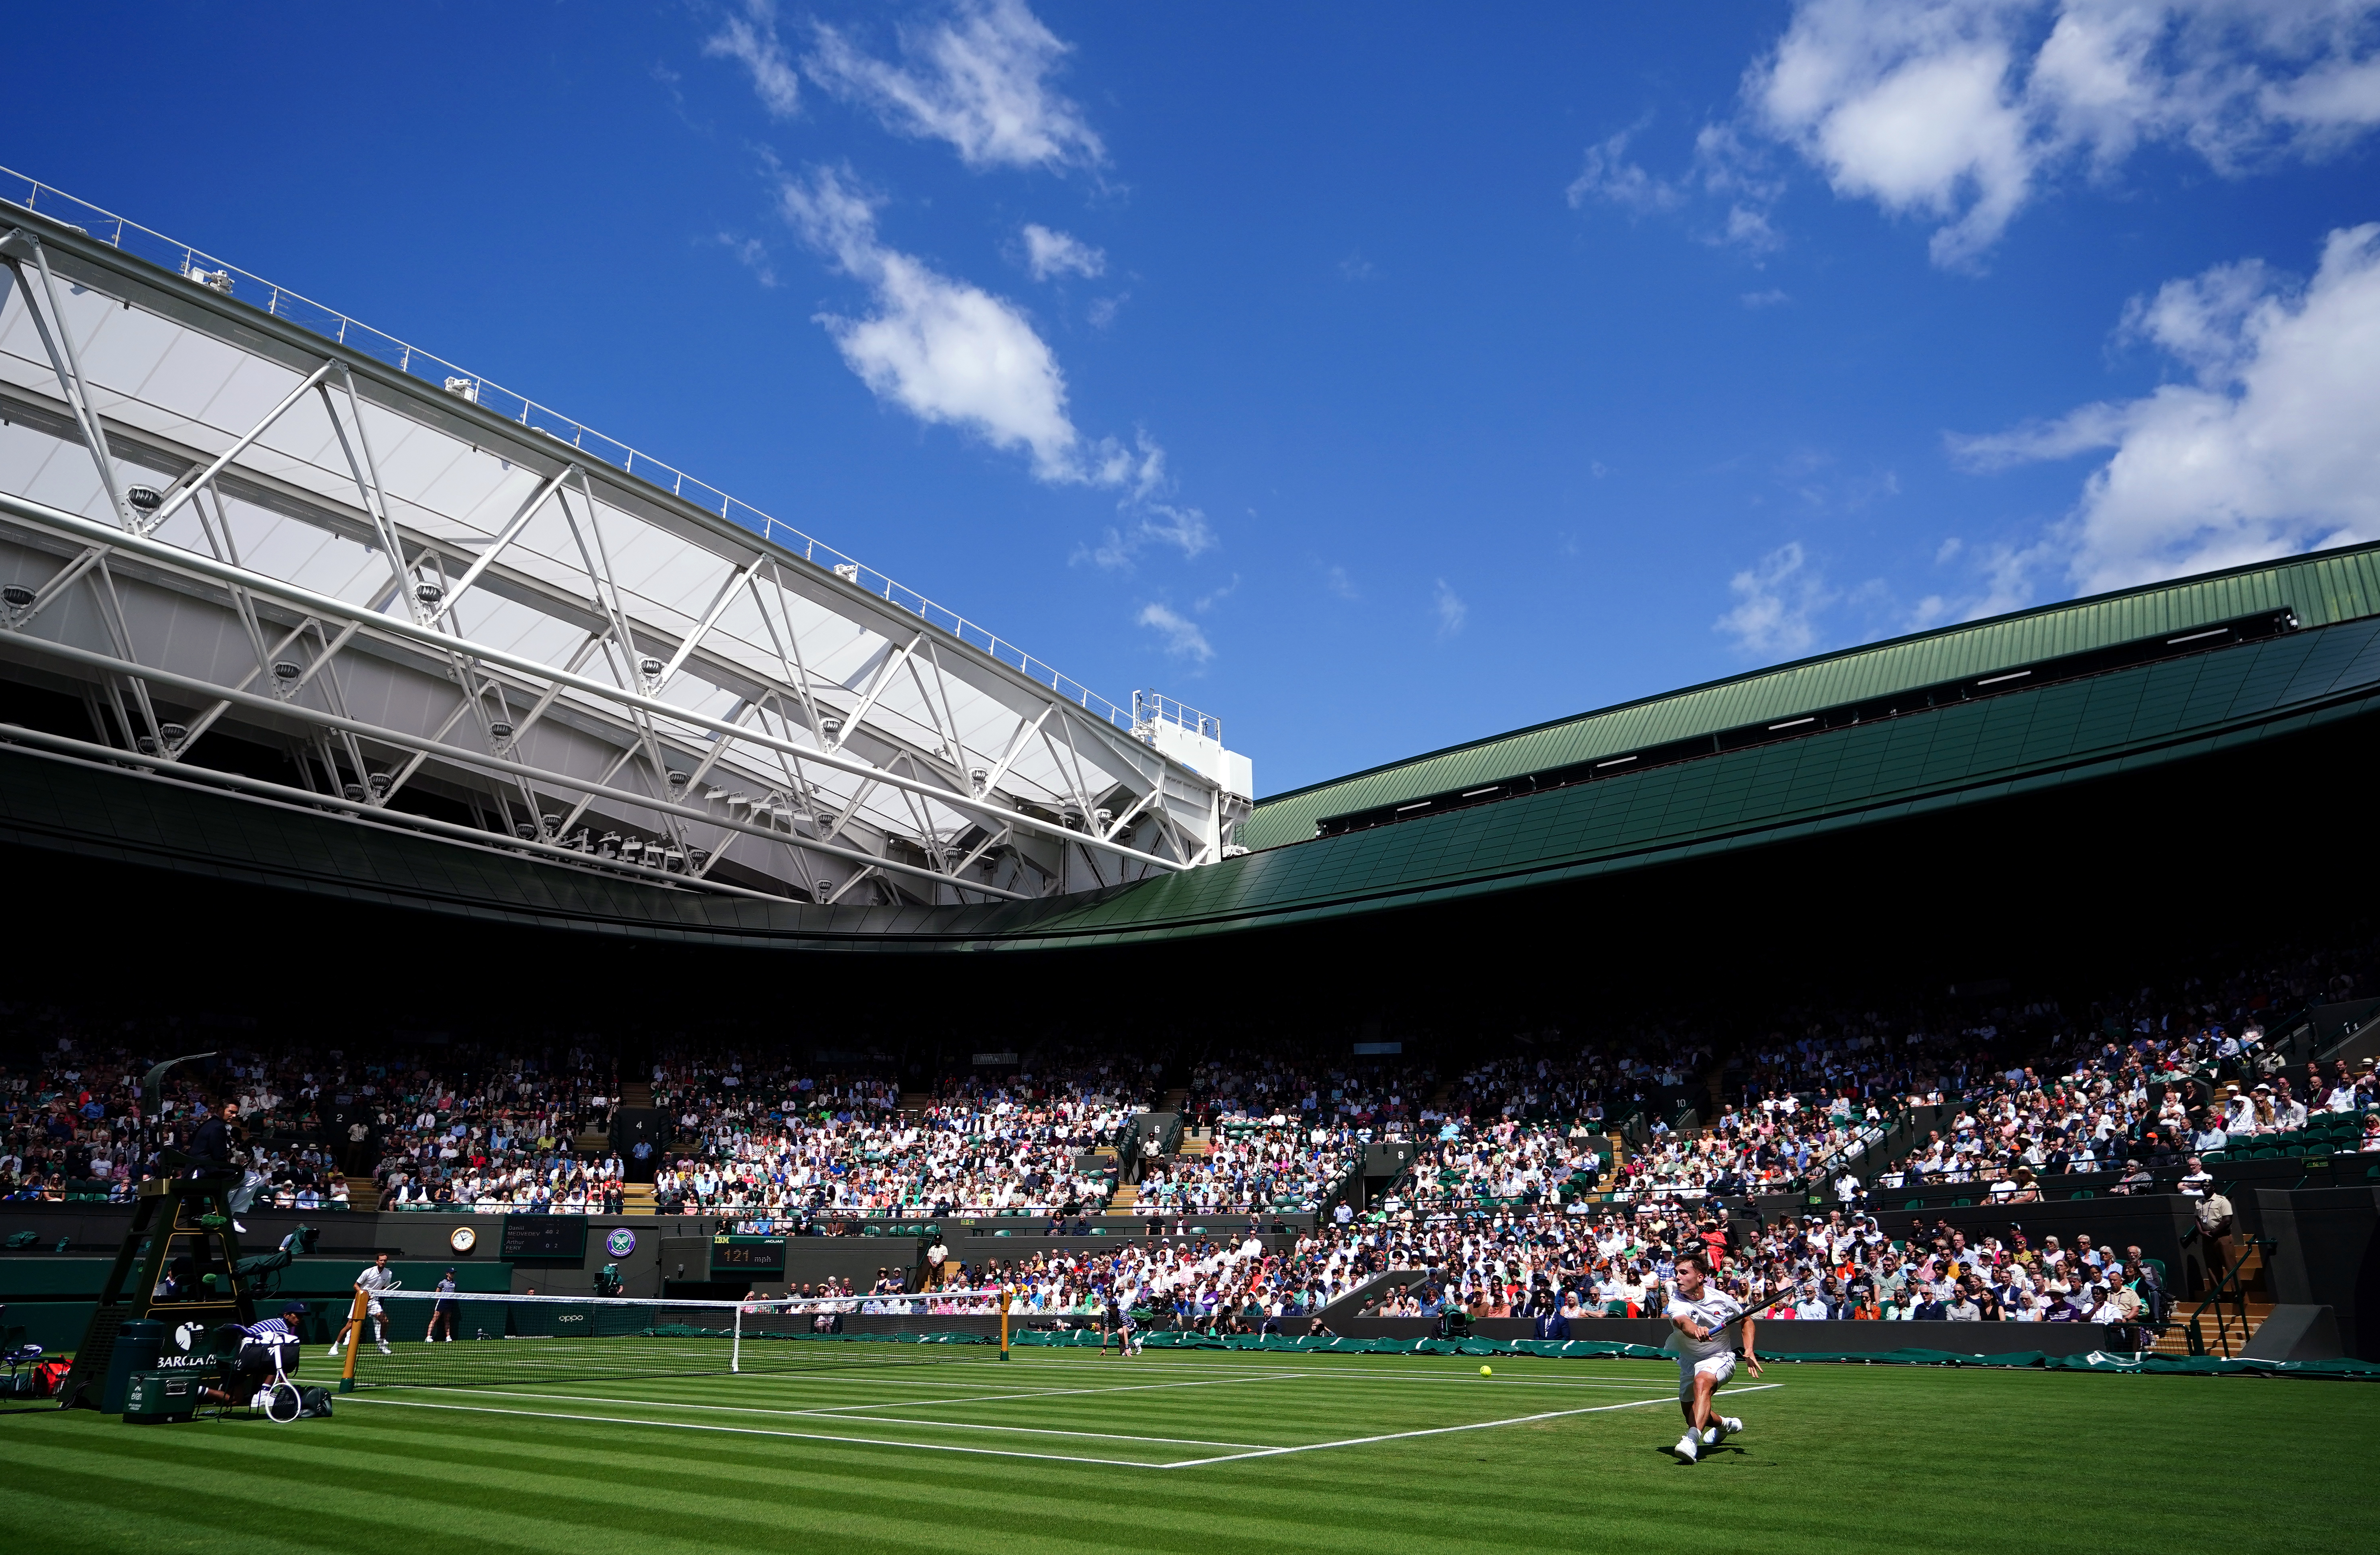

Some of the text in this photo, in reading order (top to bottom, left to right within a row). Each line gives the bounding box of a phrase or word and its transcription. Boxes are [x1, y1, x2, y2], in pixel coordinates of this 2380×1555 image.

[1676, 1099, 1686, 1107] 10
[336, 1114, 343, 1122] 2
[636, 1121, 643, 1129] 4
[1154, 1125, 1160, 1133] 6
[724, 1249, 749, 1261] 121
